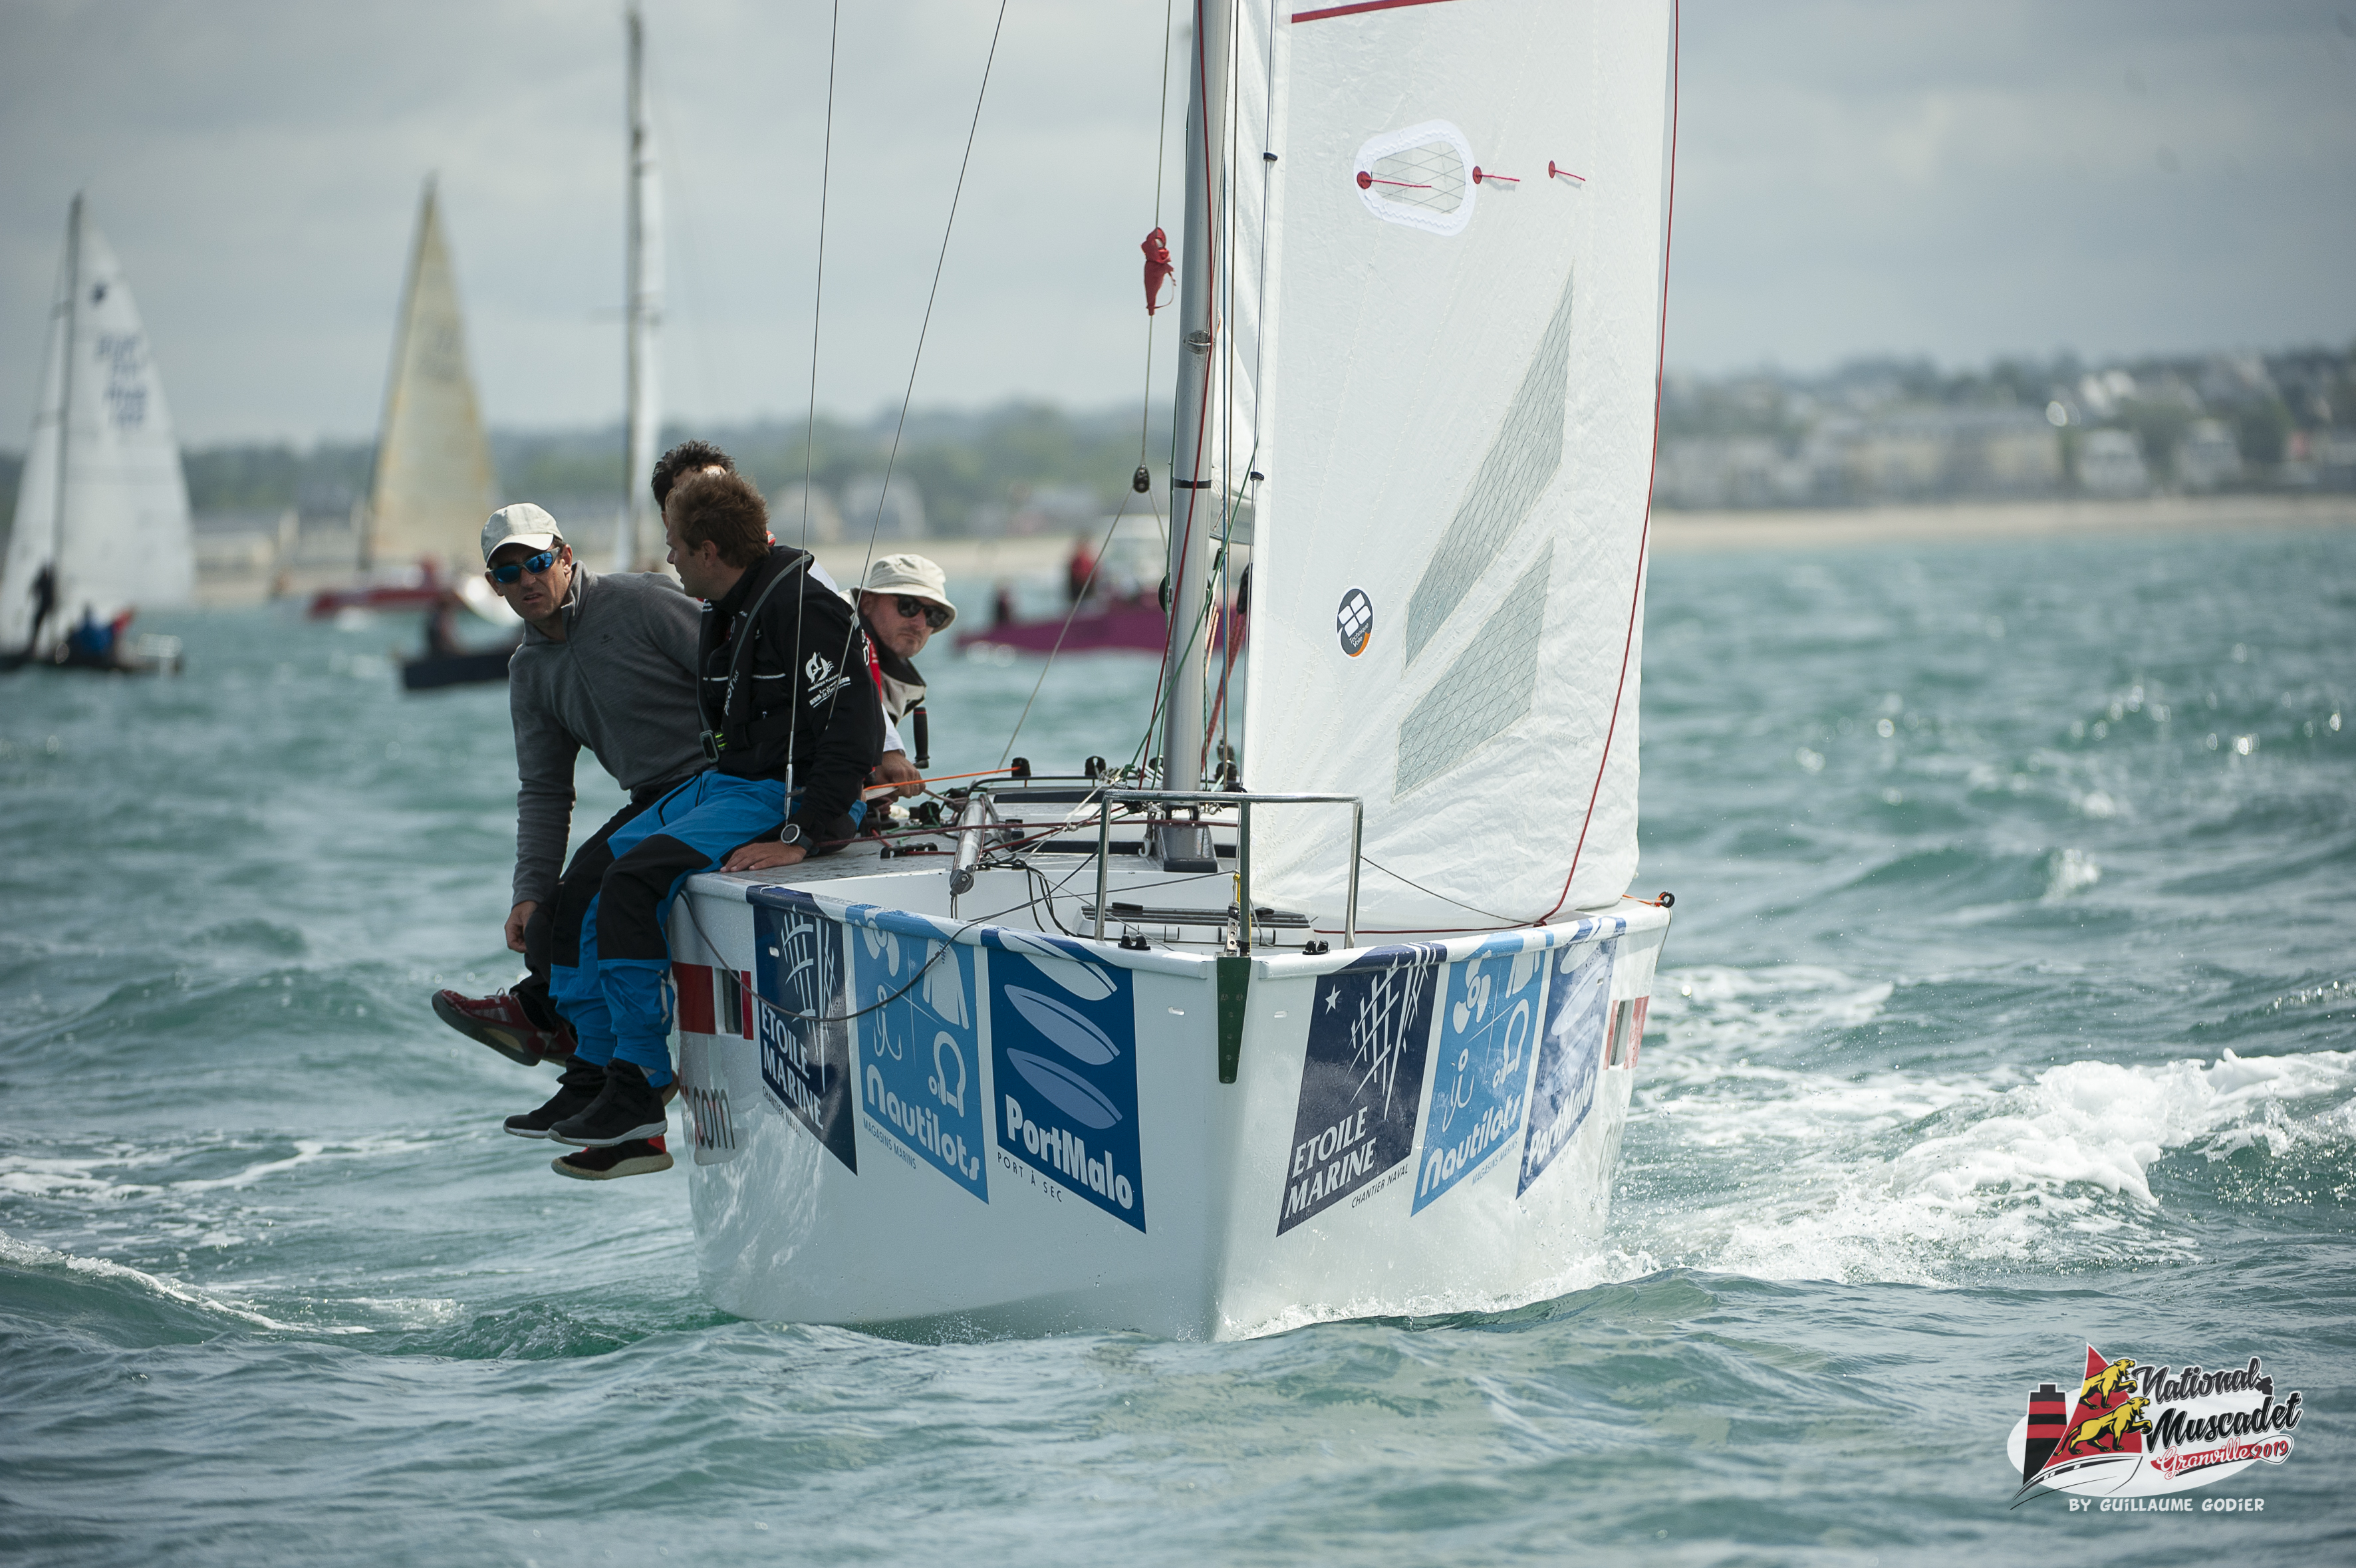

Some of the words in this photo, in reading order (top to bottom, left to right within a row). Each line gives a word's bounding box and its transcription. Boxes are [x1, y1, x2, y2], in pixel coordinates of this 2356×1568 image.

[1349, 623, 1369, 644] Technique
[761, 1000, 810, 1080] ETOILE
[763, 1039, 824, 1130] MARINE
[762, 1086, 785, 1120] CHANTIER
[785, 1112, 802, 1138] NAVAL
[863, 1117, 892, 1150] MAGASINS
[894, 1143, 916, 1170] MARINS
[1005, 1093, 1133, 1210] PortMalo
[1291, 1105, 1368, 1178] ETOILE
[1471, 1155, 1498, 1186] MAGASINS
[1499, 1136, 1518, 1162] MARINS
[997, 1152, 1023, 1178] PORT
[1031, 1170, 1036, 1186] À
[1043, 1181, 1062, 1203] SEC
[1284, 1137, 1376, 1220] MARINE
[1351, 1181, 1385, 1208] CHANTIER
[1387, 1164, 1408, 1186] NAVAL
